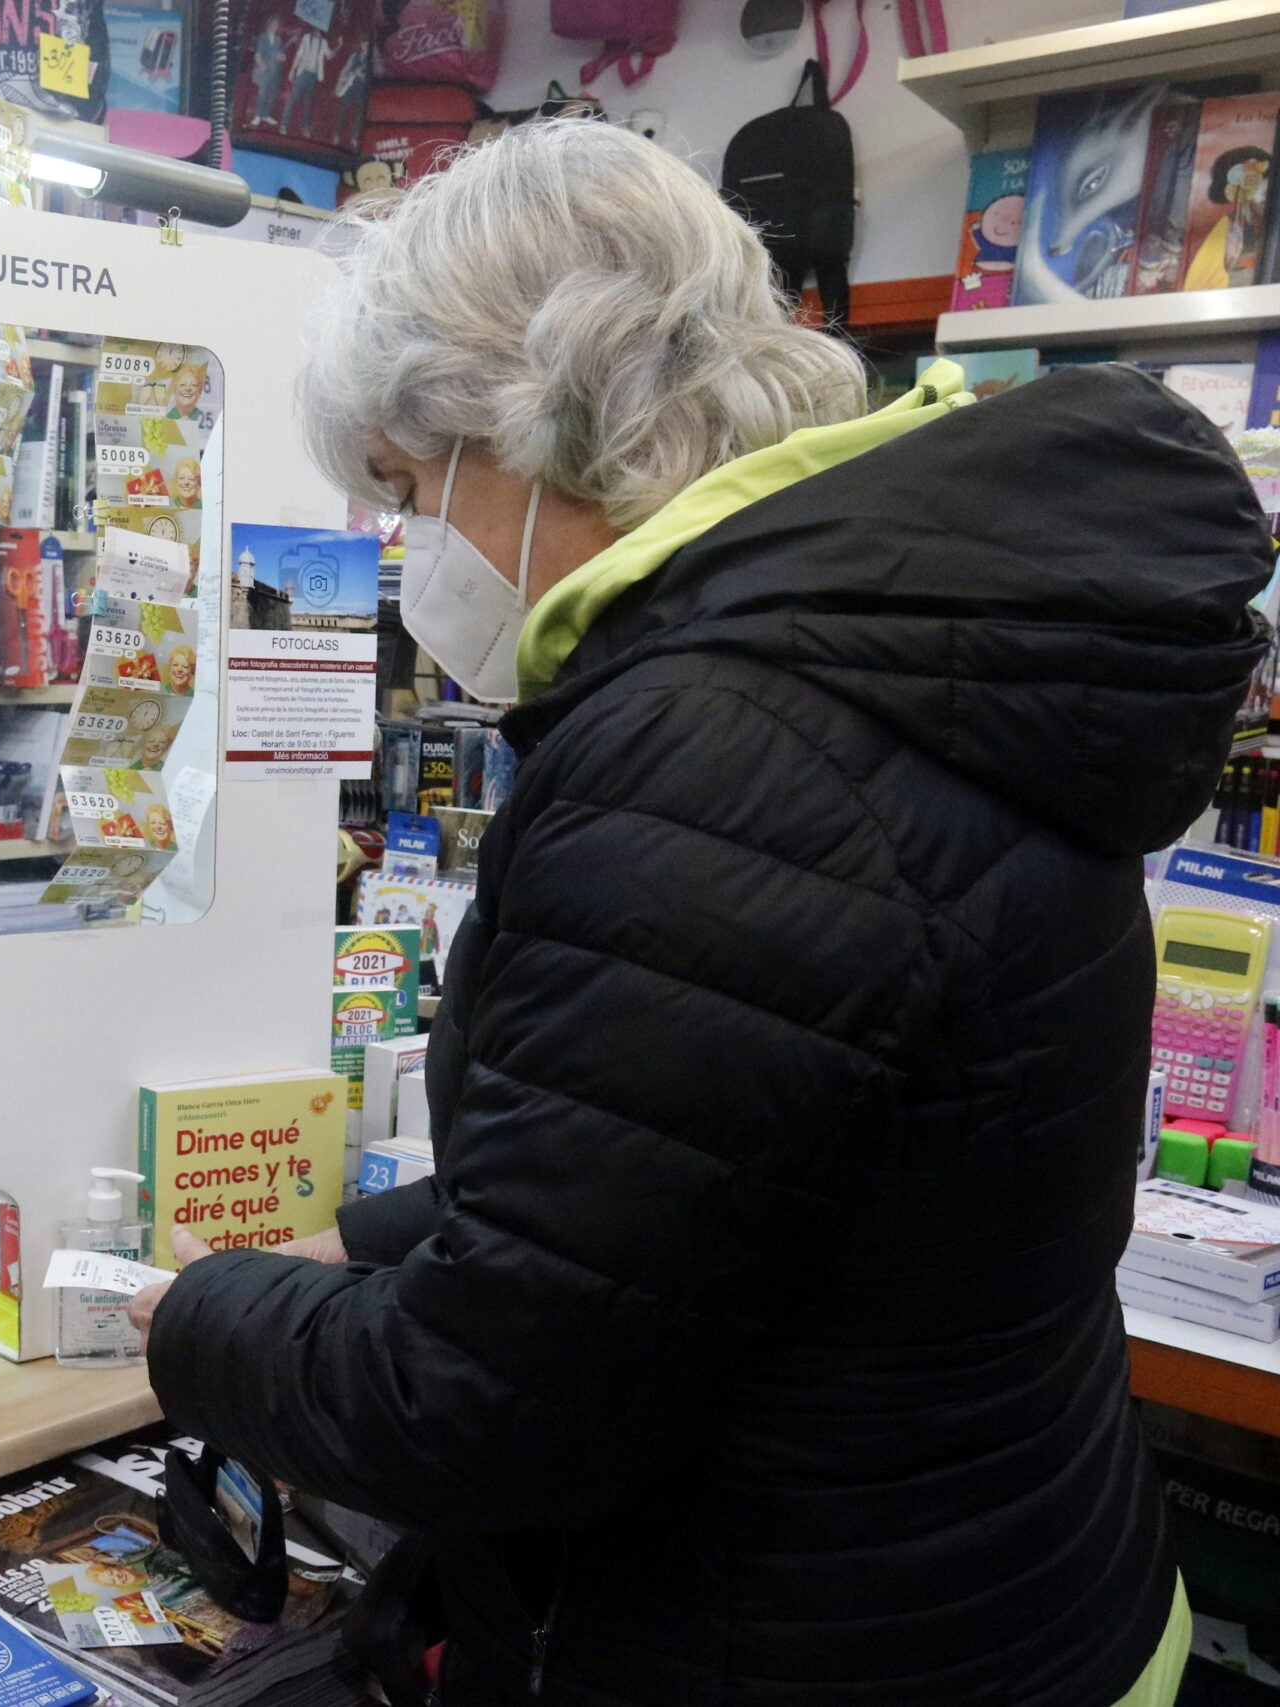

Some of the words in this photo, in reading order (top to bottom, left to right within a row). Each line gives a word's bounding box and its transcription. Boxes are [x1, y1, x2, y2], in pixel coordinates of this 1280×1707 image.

[375, 137, 410, 151] SMILE
[267, 224, 302, 241] gener
[104, 356, 150, 373] 50089
[103, 422, 127, 434] Grossa
[198, 410, 214, 431] 25
[100, 448, 145, 463] 50089
[139, 560, 169, 572] Catalunya
[95, 629, 141, 647] 63620
[271, 637, 339, 651] FOTOCLASS
[77, 715, 123, 731] 63620
[273, 751, 290, 760] Més
[291, 751, 329, 760] informació
[71, 794, 115, 809] 63620
[398, 838, 427, 850] MILAN
[61, 867, 106, 878] 63620
[1176, 859, 1225, 880] MILAN
[352, 955, 387, 970] 2021
[347, 1009, 372, 1021] 2021
[345, 1024, 373, 1036] BLOC
[176, 1128, 246, 1156] Dime
[250, 1118, 301, 1155] qué
[174, 1163, 260, 1191] comes
[265, 1161, 281, 1187] y
[286, 1155, 313, 1177] te
[364, 1163, 390, 1190] 23
[173, 1194, 226, 1224] diré
[230, 1187, 281, 1224] qué
[205, 1222, 295, 1252] cterias
[1165, 1480, 1211, 1515] PER
[100, 1608, 125, 1644] 70711
